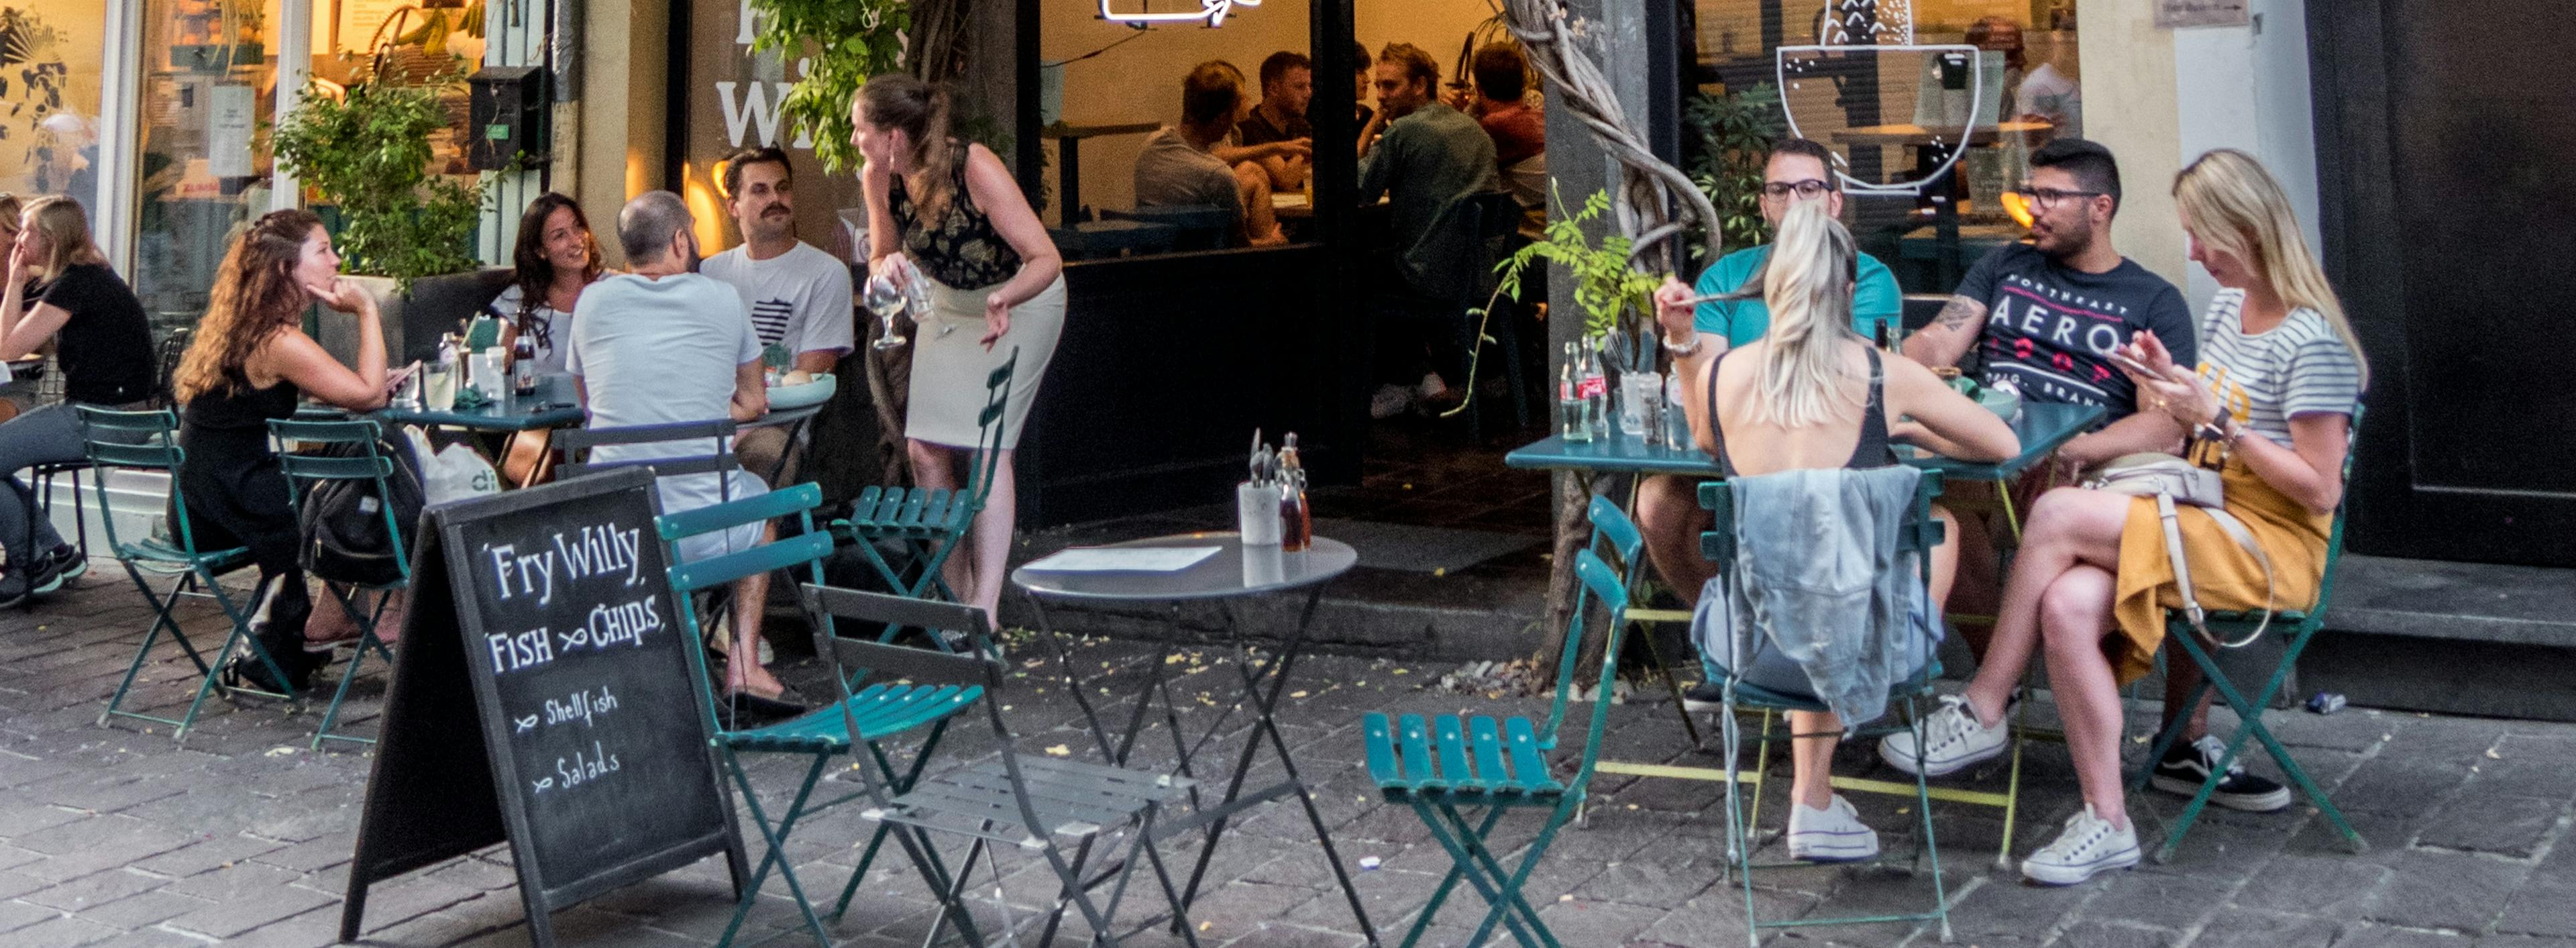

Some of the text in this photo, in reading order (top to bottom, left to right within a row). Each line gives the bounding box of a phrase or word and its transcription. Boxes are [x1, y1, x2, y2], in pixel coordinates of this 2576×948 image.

[2007, 274, 2128, 315] NORTHEAST
[1989, 295, 2120, 356] AERO
[545, 685, 619, 727] Shellfish
[557, 739, 621, 789] Salads
